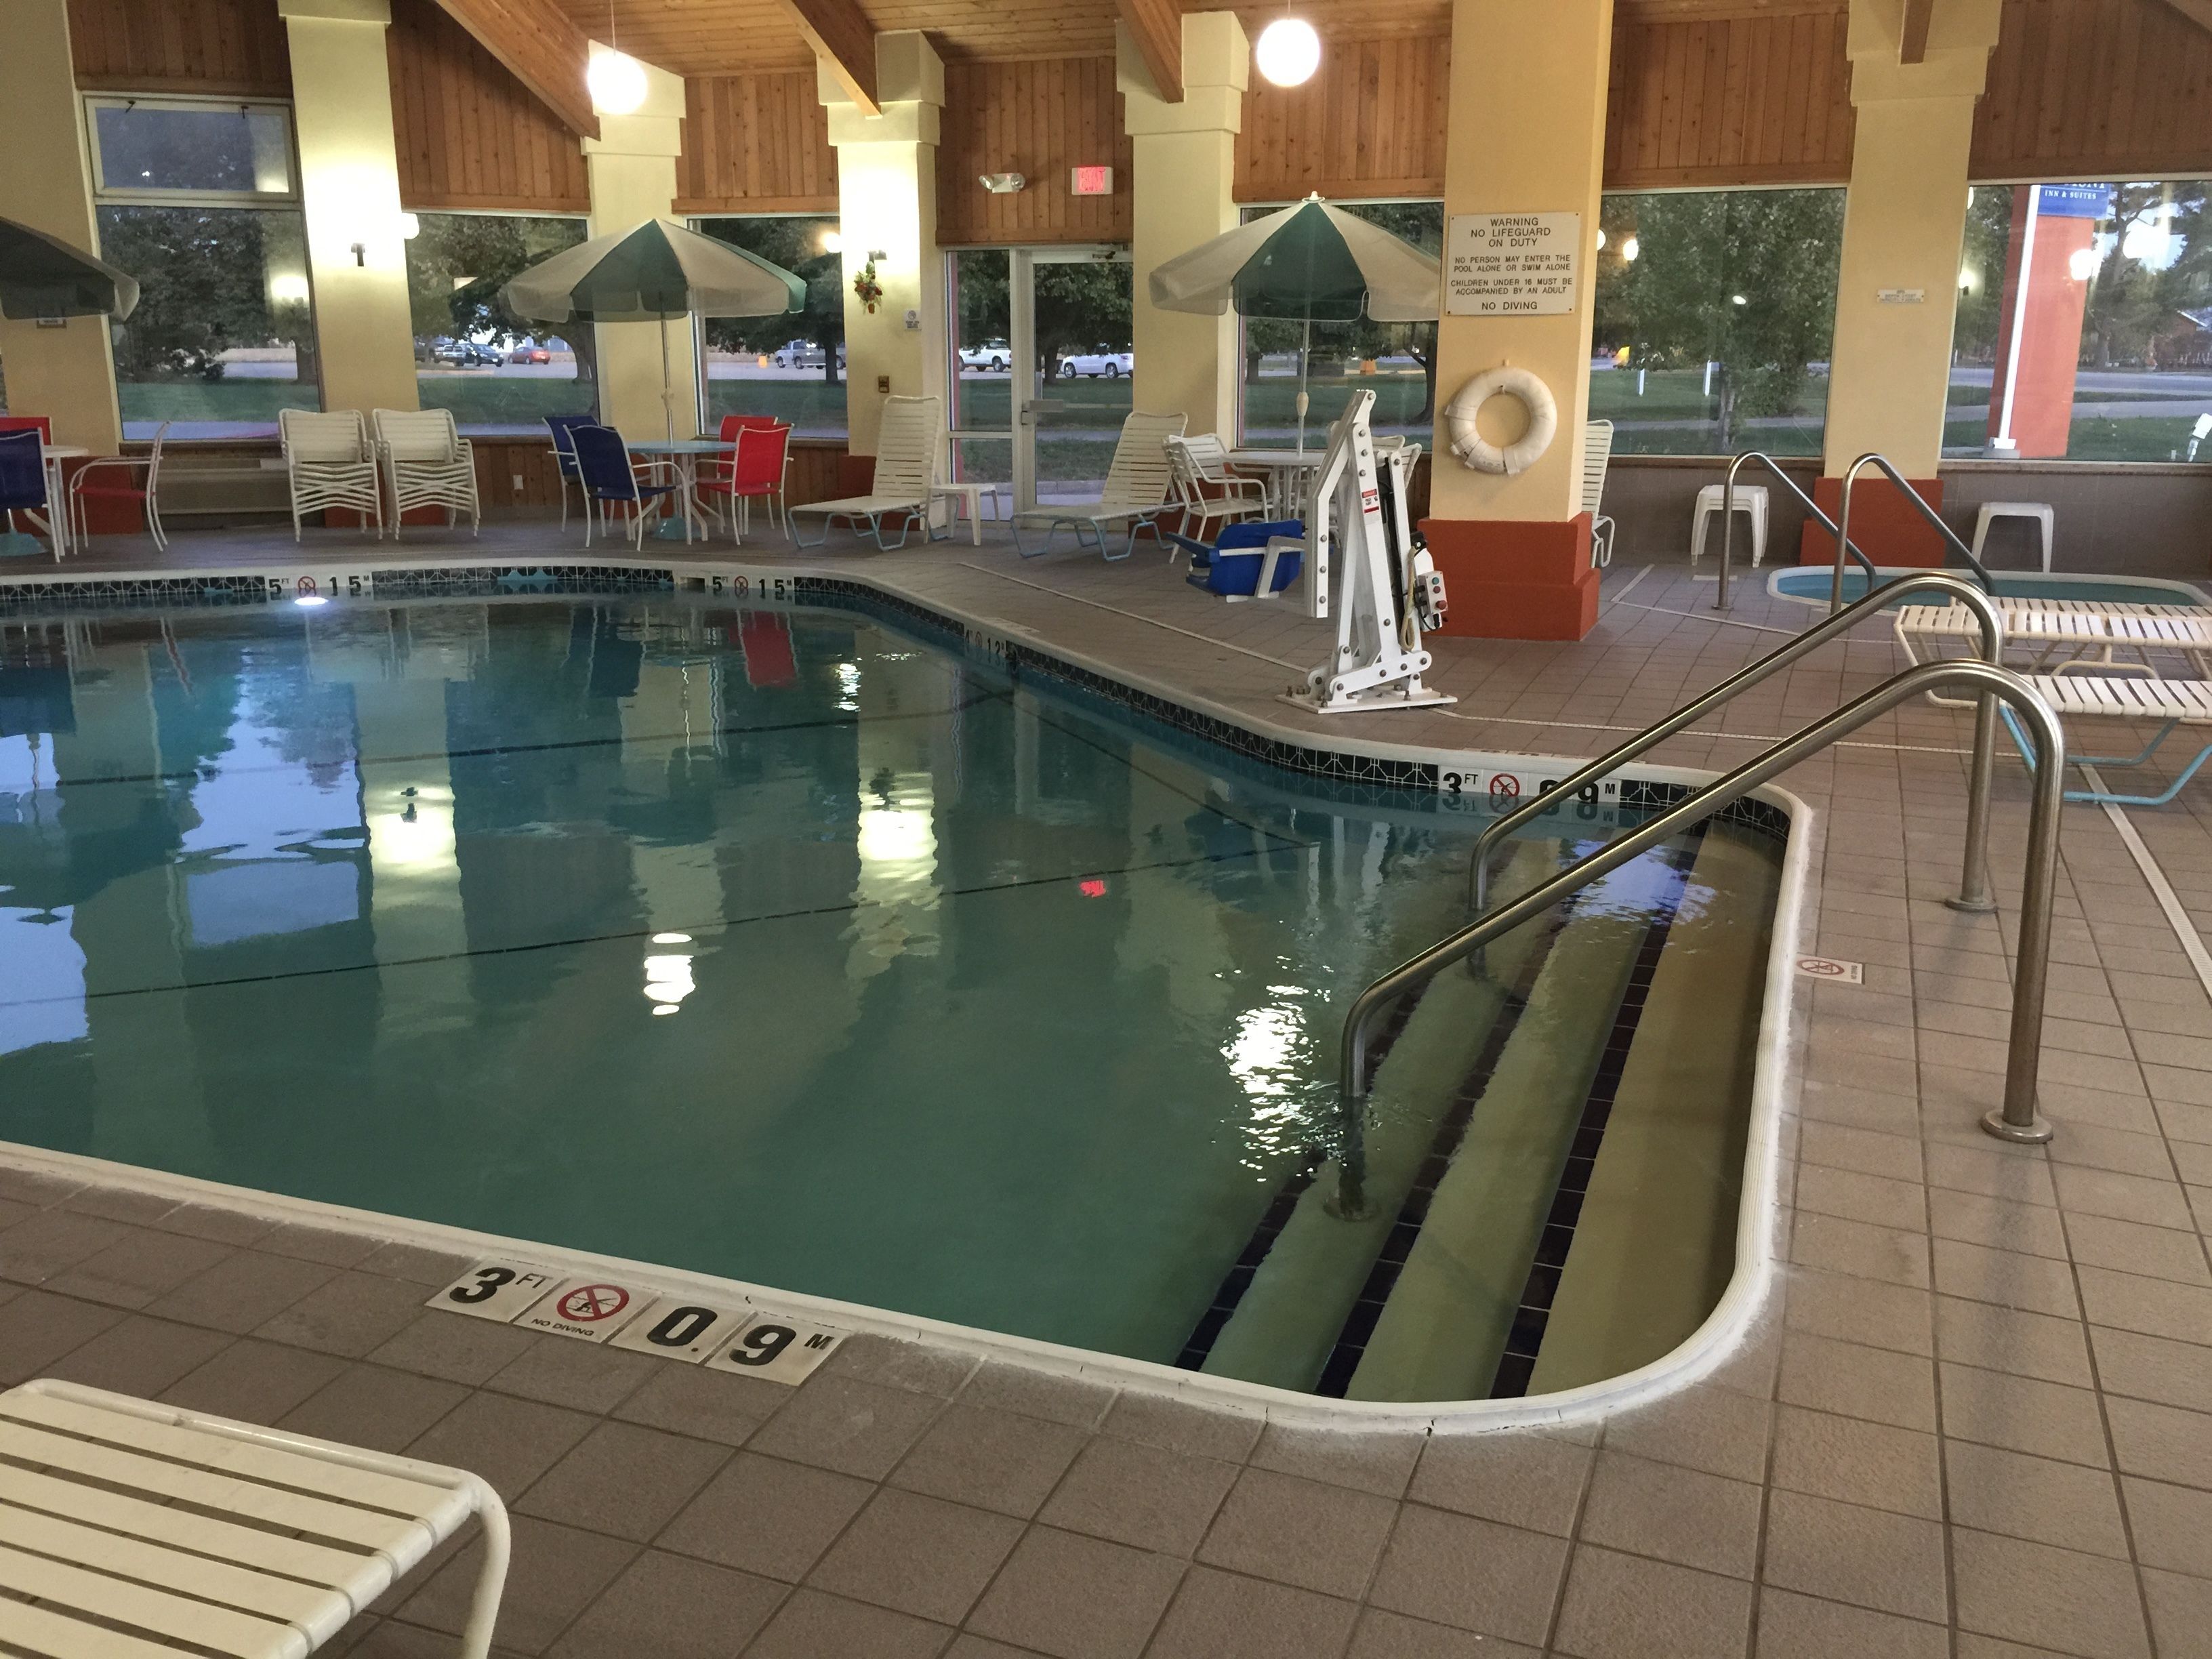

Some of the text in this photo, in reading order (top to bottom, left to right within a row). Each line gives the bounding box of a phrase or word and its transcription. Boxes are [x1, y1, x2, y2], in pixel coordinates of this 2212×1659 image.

[2069, 192, 2097, 200] SUITES
[1490, 217, 1539, 226] WARNING
[1471, 227, 1551, 237] NO LIFEGUARD
[1488, 238, 1538, 247] ON DUTY
[1456, 287, 1509, 295] ACCOMPANIED
[1481, 301, 1538, 310] NO DIVING
[268, 579, 282, 594] 5
[712, 576, 722, 591] 5
[1443, 772, 1478, 794] 3 FT
[1605, 783, 1616, 794] M
[449, 1267, 548, 1304] 3 FT
[531, 1317, 596, 1337] NO DIVING
[804, 1333, 836, 1350] M
